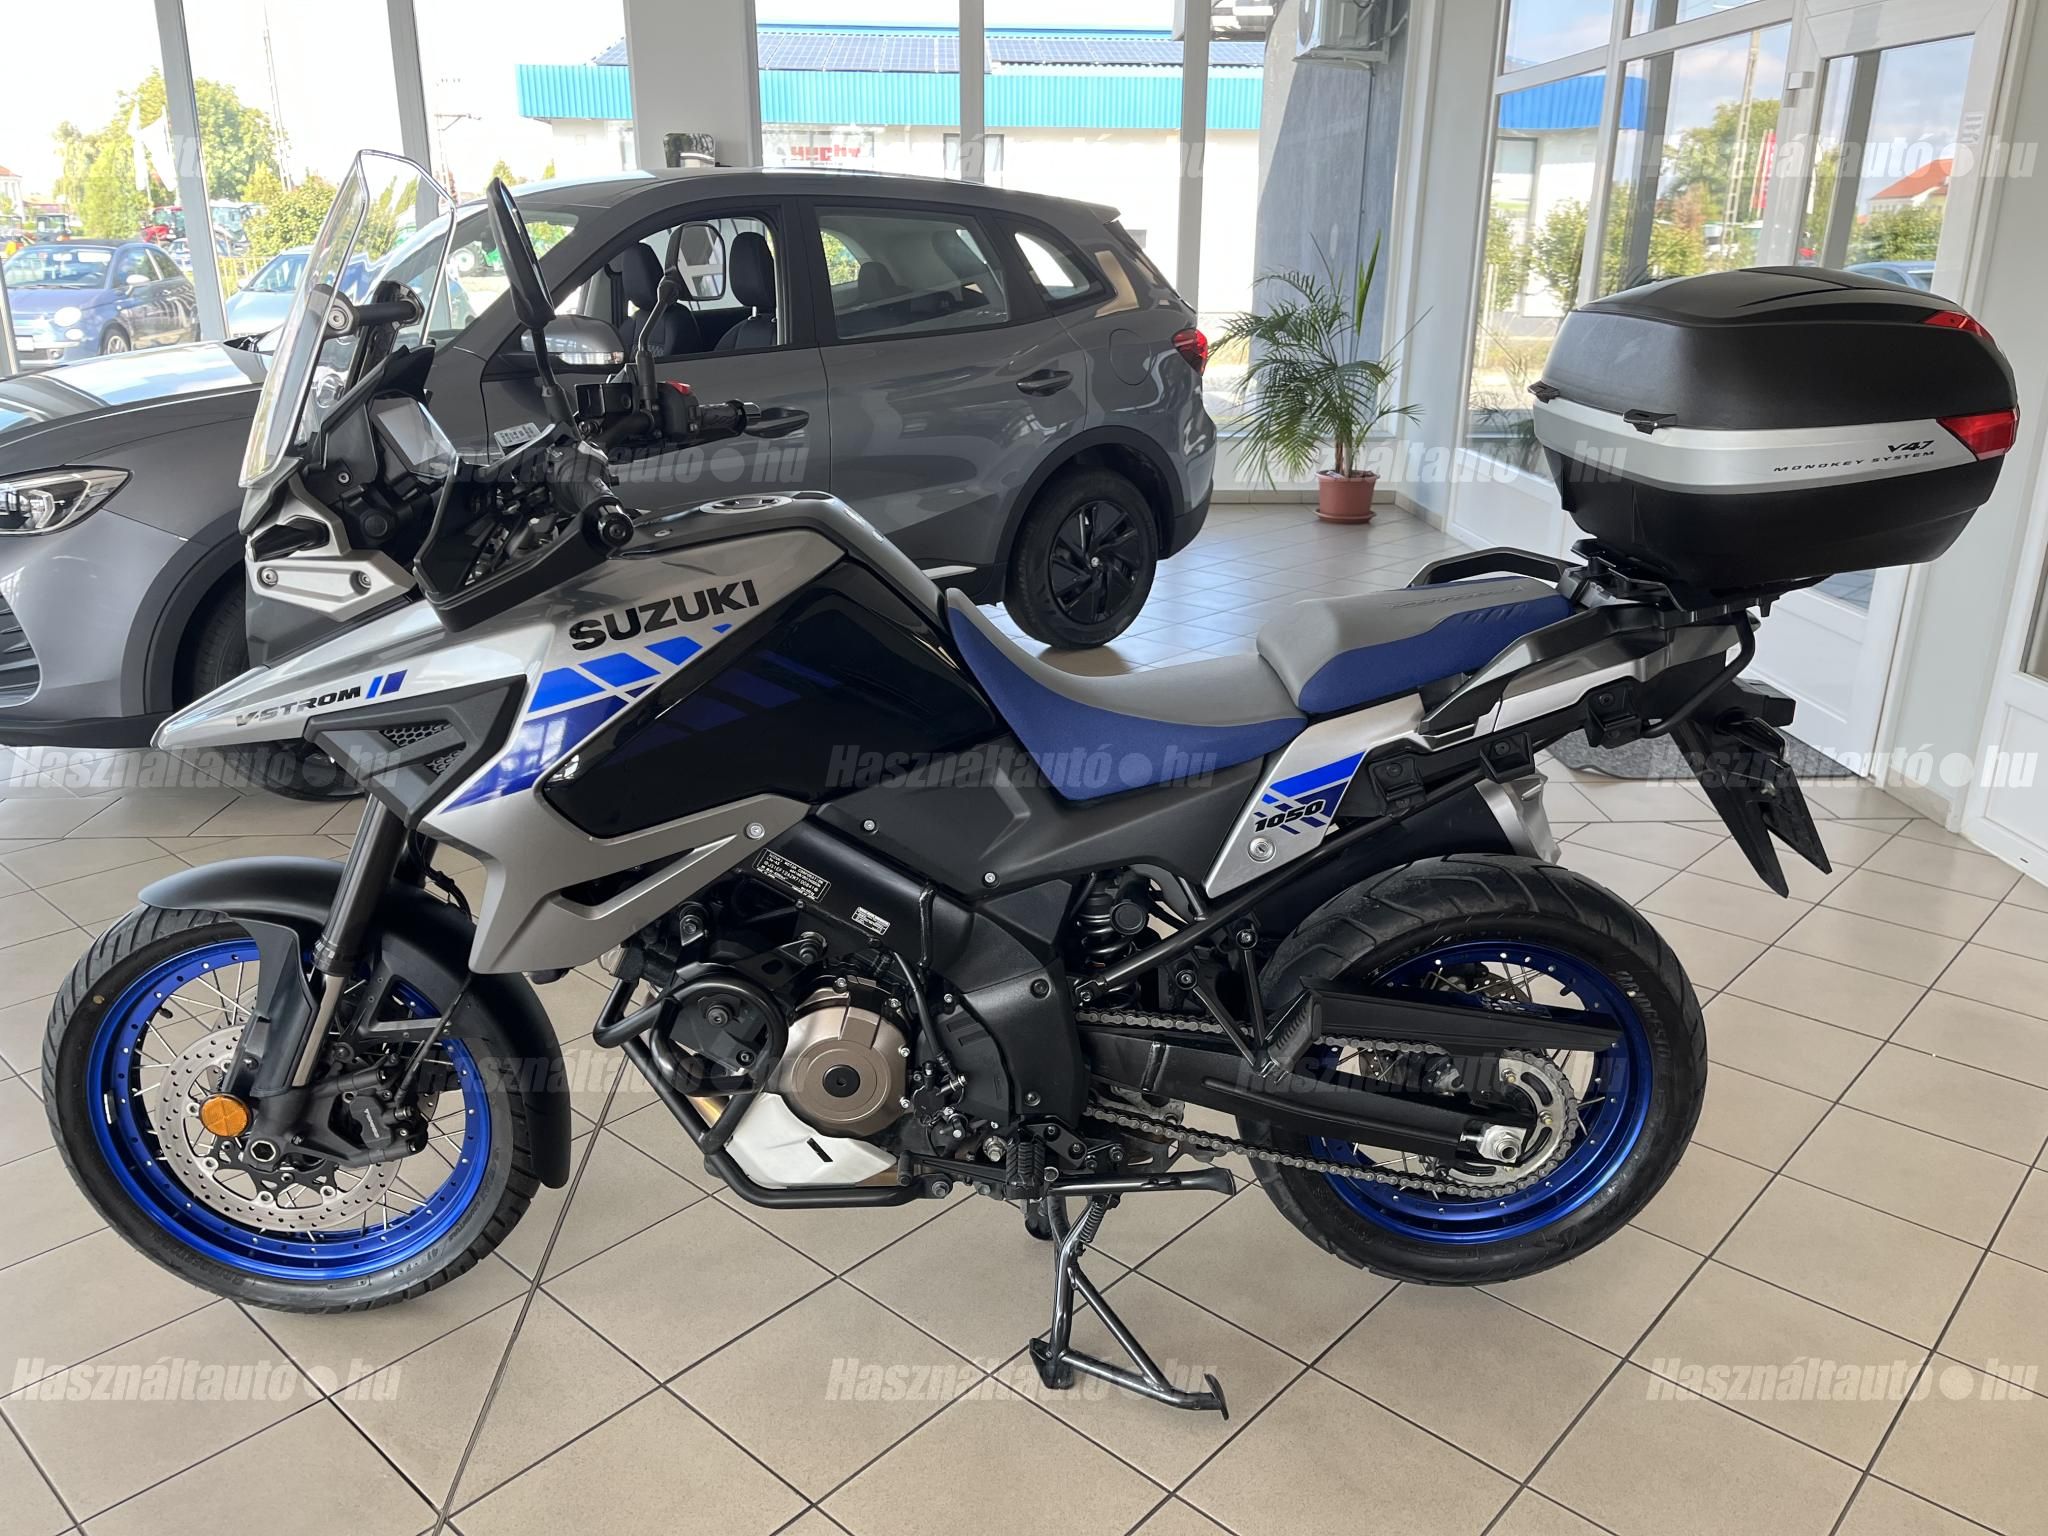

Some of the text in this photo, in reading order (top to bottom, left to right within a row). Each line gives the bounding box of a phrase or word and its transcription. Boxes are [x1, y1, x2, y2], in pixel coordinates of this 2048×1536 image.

[1773, 451, 1935, 472] MONOKEY SYSTEM
[1888, 440, 1935, 452] V47
[568, 579, 760, 651] SUZUKI
[235, 686, 361, 727] V-STROM
[1254, 800, 1325, 832] 1050
